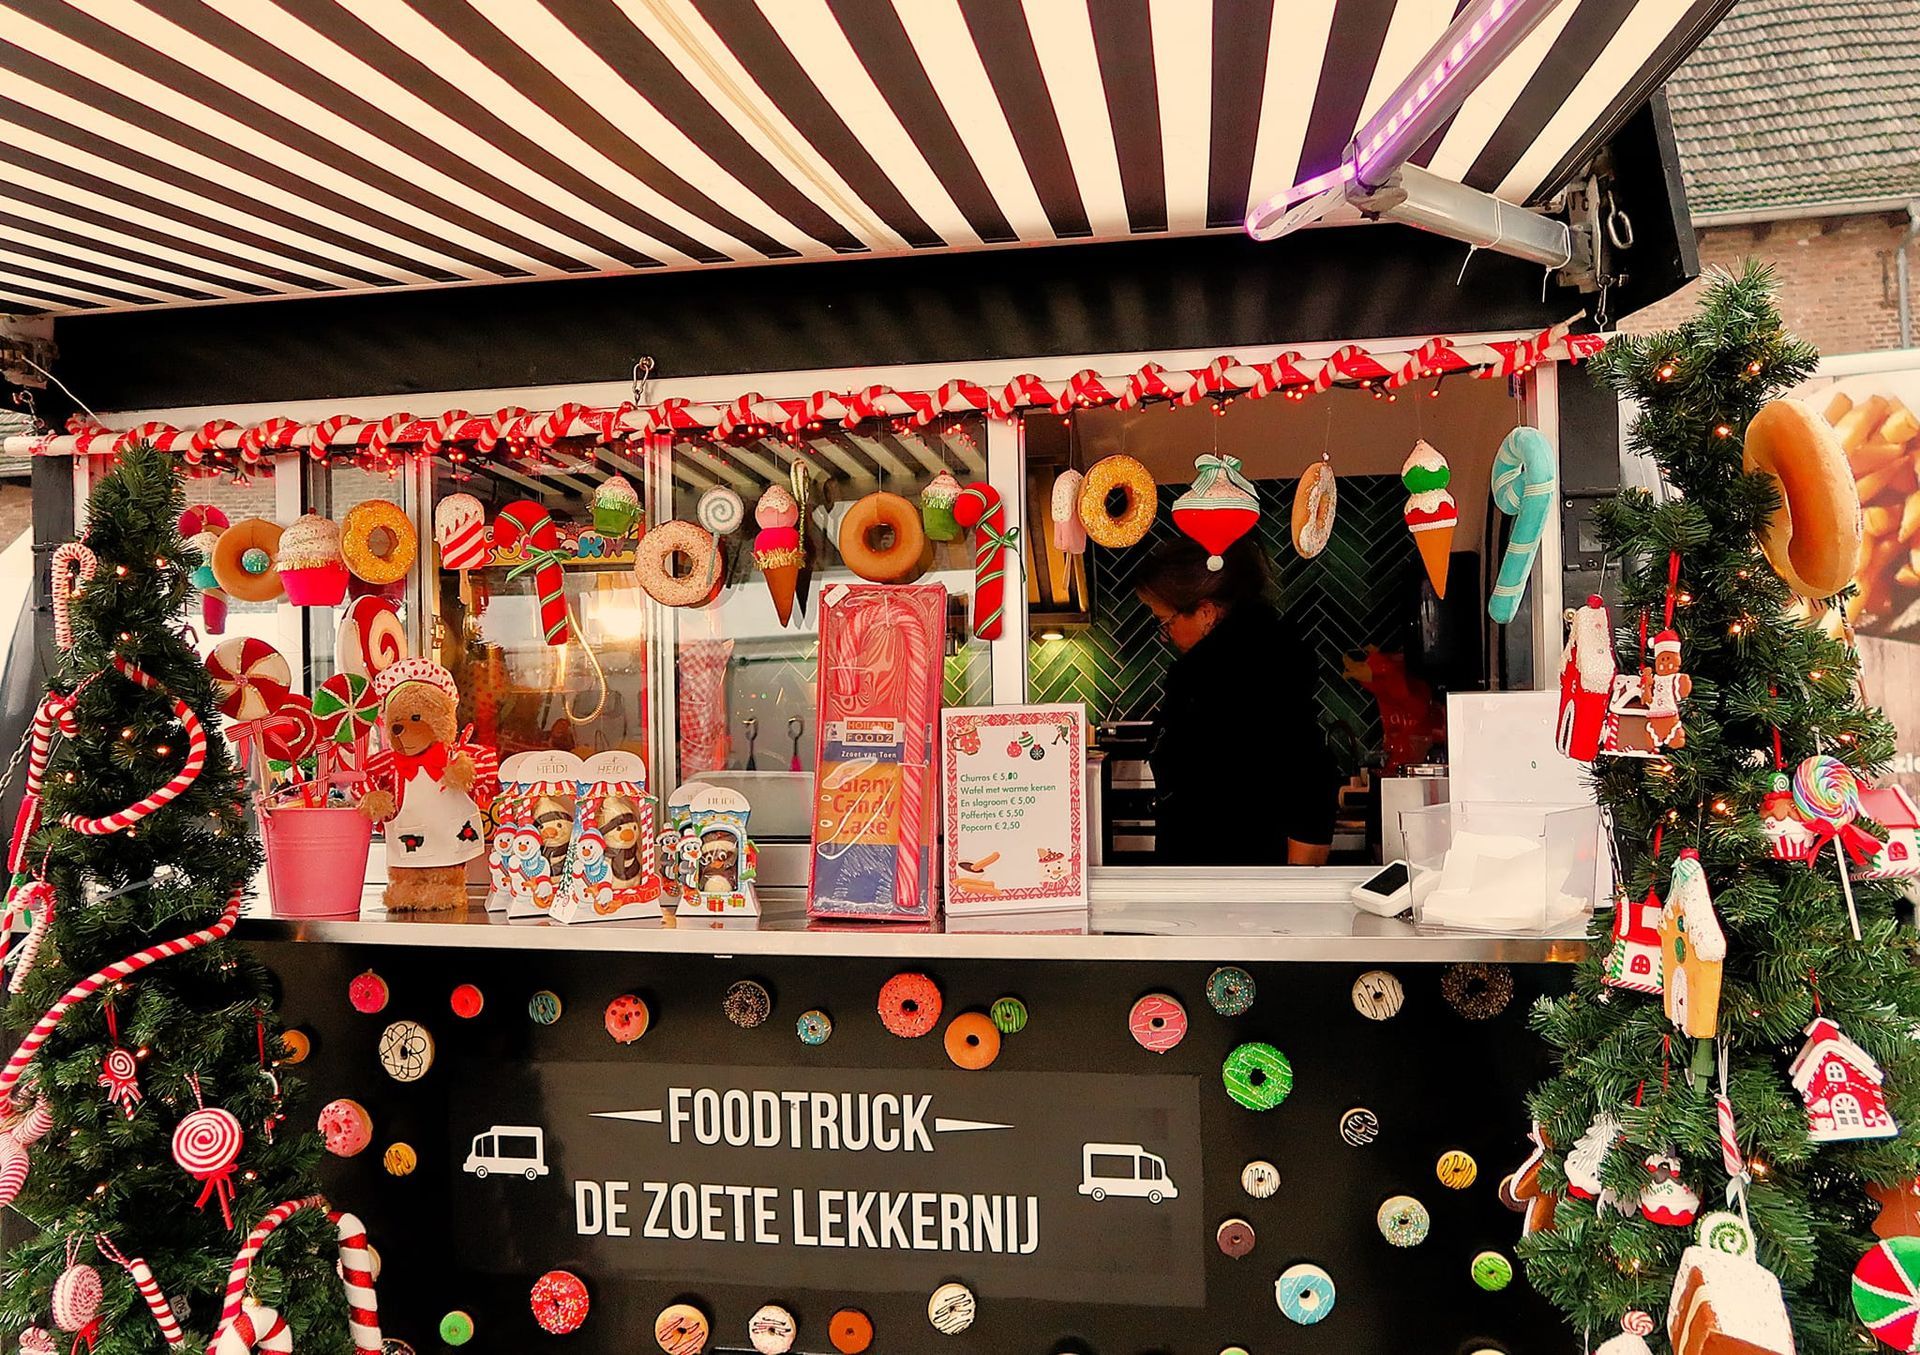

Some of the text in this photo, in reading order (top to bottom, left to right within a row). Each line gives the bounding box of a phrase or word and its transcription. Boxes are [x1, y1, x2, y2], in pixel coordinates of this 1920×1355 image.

[846, 733, 893, 743] FOODZ
[536, 763, 568, 774] HEIDI
[597, 764, 629, 775] HEIDI
[960, 773, 990, 782] Churros
[960, 785, 984, 795] Wafel
[1030, 783, 1056, 792] kersen
[832, 794, 895, 818] Candy
[960, 799, 970, 807] En
[972, 798, 1008, 808] slagroom
[1018, 796, 1036, 805] 5,00
[960, 811, 996, 821] Poffertjes
[1006, 808, 1024, 818] 5,50
[960, 824, 992, 832] Popcorn
[1002, 821, 1020, 831] 2,50
[667, 1086, 934, 1152] FOODTRUCK
[574, 1179, 1040, 1255] DE ZOETE LEKKERNIJ
